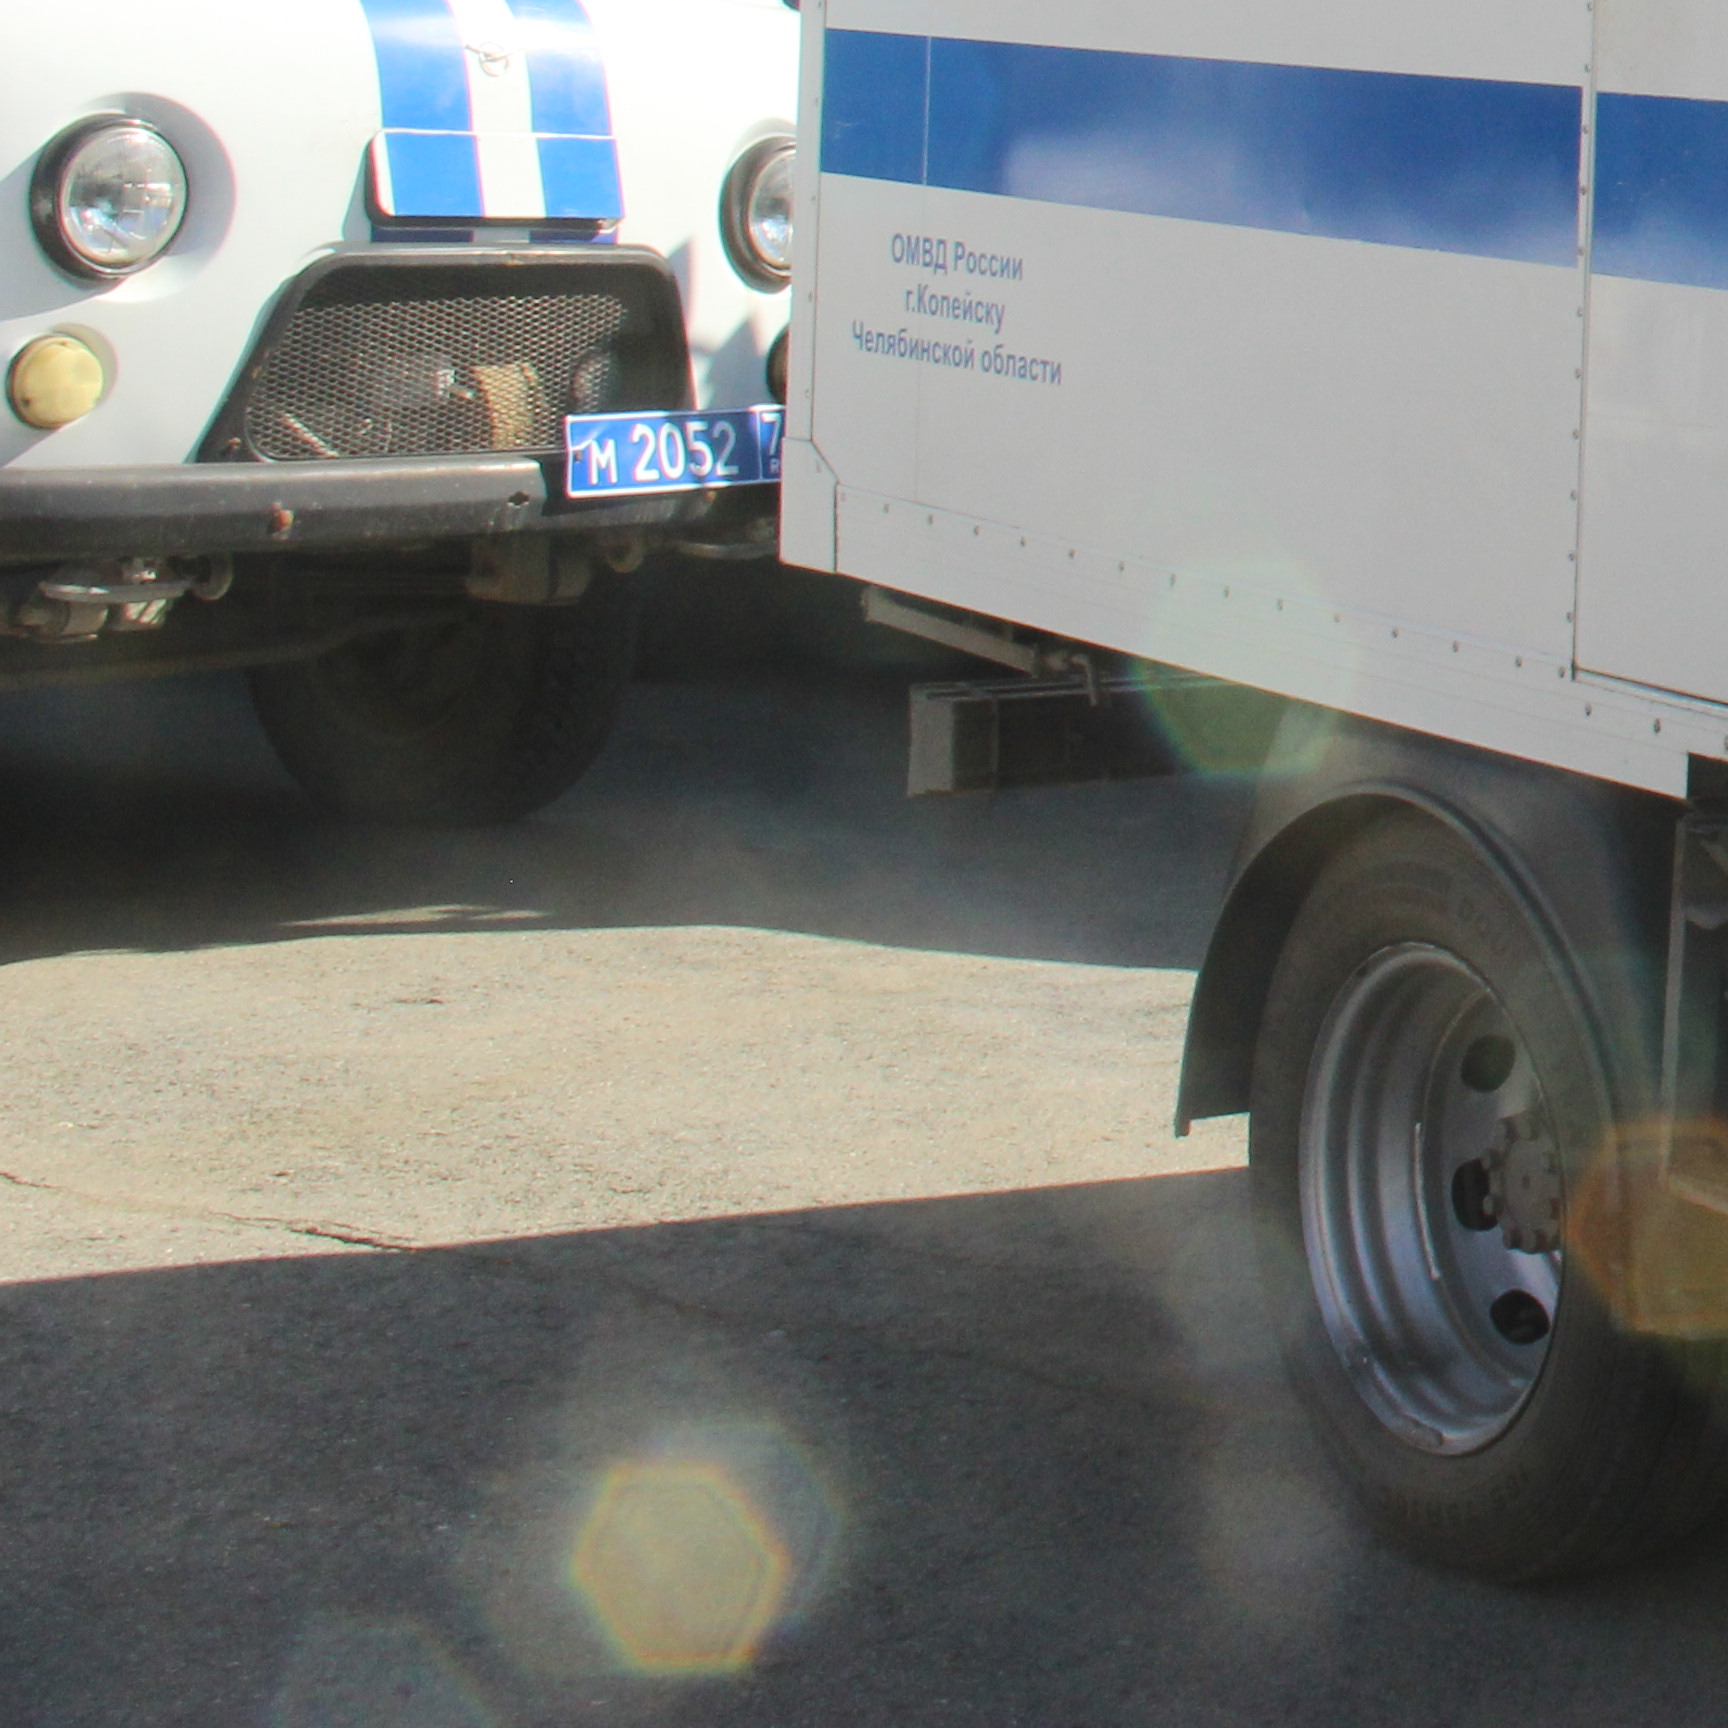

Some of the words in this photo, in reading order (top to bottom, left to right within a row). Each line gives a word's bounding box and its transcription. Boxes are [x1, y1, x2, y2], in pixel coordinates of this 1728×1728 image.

[890, 232, 948, 276] ОМВД
[953, 240, 1025, 281] России
[904, 283, 1006, 335] г.Копейску
[851, 319, 976, 372] Челябинской
[981, 344, 1063, 386] области
[630, 419, 740, 482] 2052
[760, 412, 783, 456] 7
